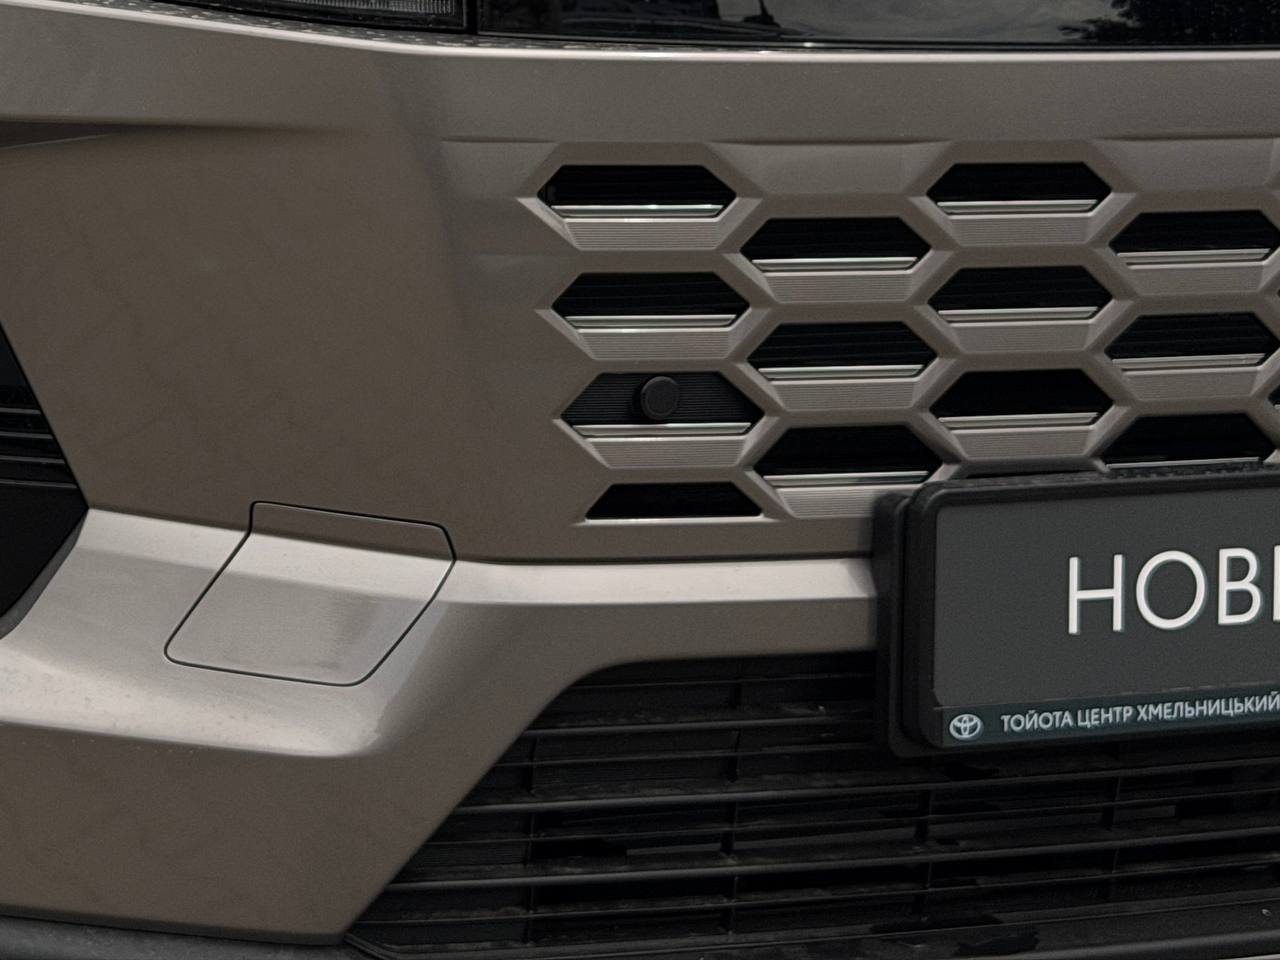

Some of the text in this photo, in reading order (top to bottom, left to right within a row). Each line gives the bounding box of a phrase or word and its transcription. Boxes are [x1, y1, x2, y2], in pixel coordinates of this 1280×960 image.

[1068, 545, 1280, 634] НОВ
[1000, 691, 1280, 732] ТОЙОТА ЦЕНТР ХМЕЛЬНИЦЬКИЙ
